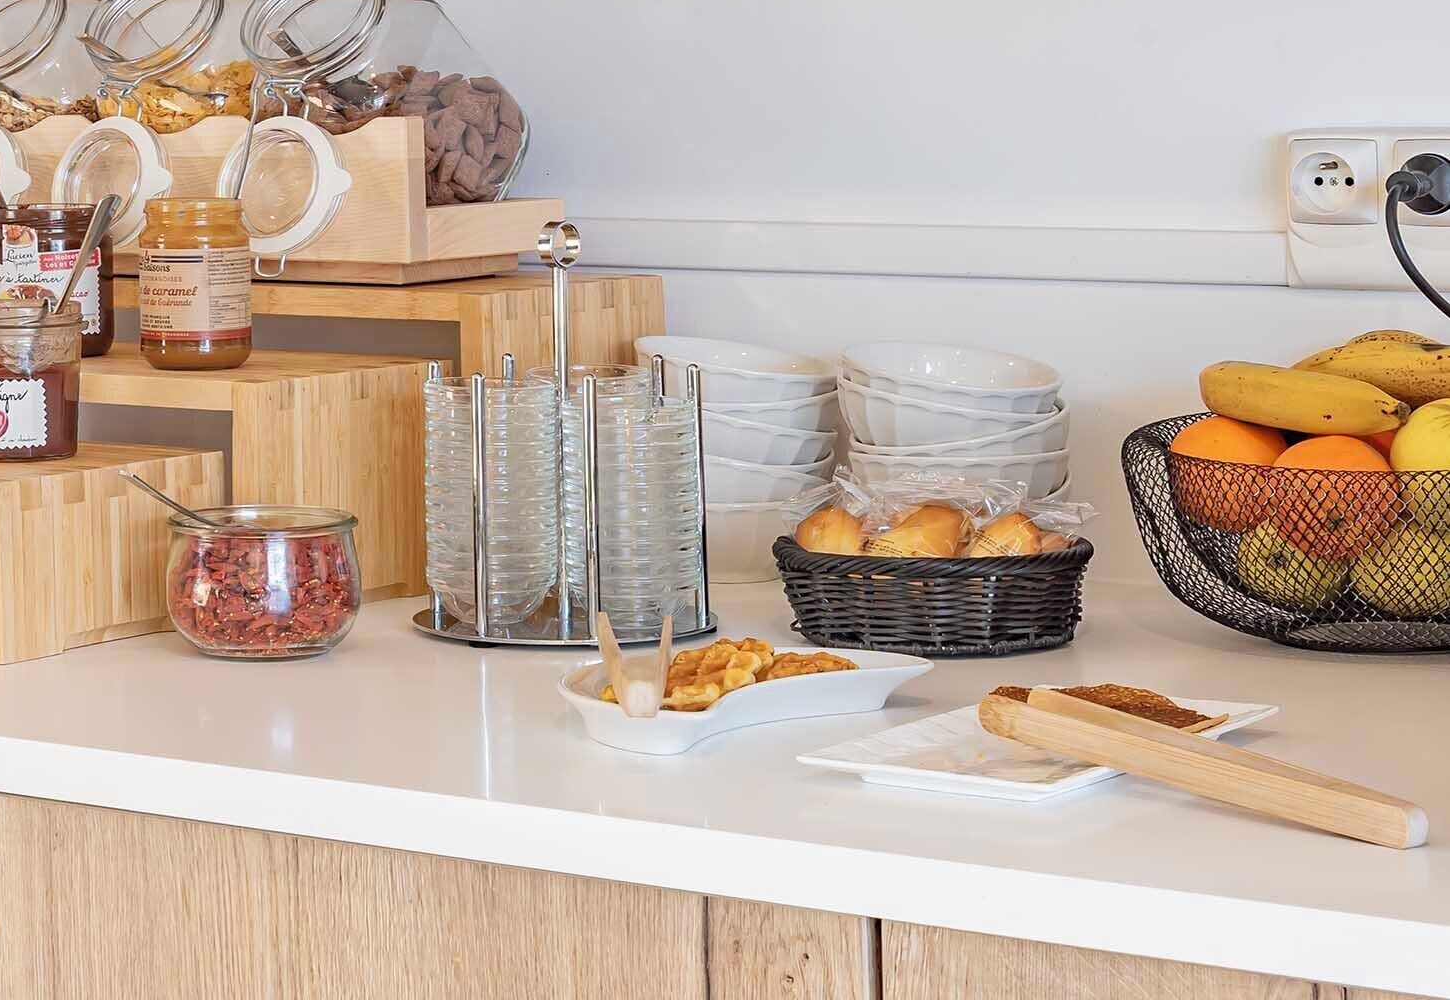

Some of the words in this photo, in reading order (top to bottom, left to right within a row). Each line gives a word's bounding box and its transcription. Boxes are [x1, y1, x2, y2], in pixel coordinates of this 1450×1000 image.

[54, 253, 79, 261] Noiset
[14, 272, 64, 283] tartiner
[152, 286, 198, 297] caramel
